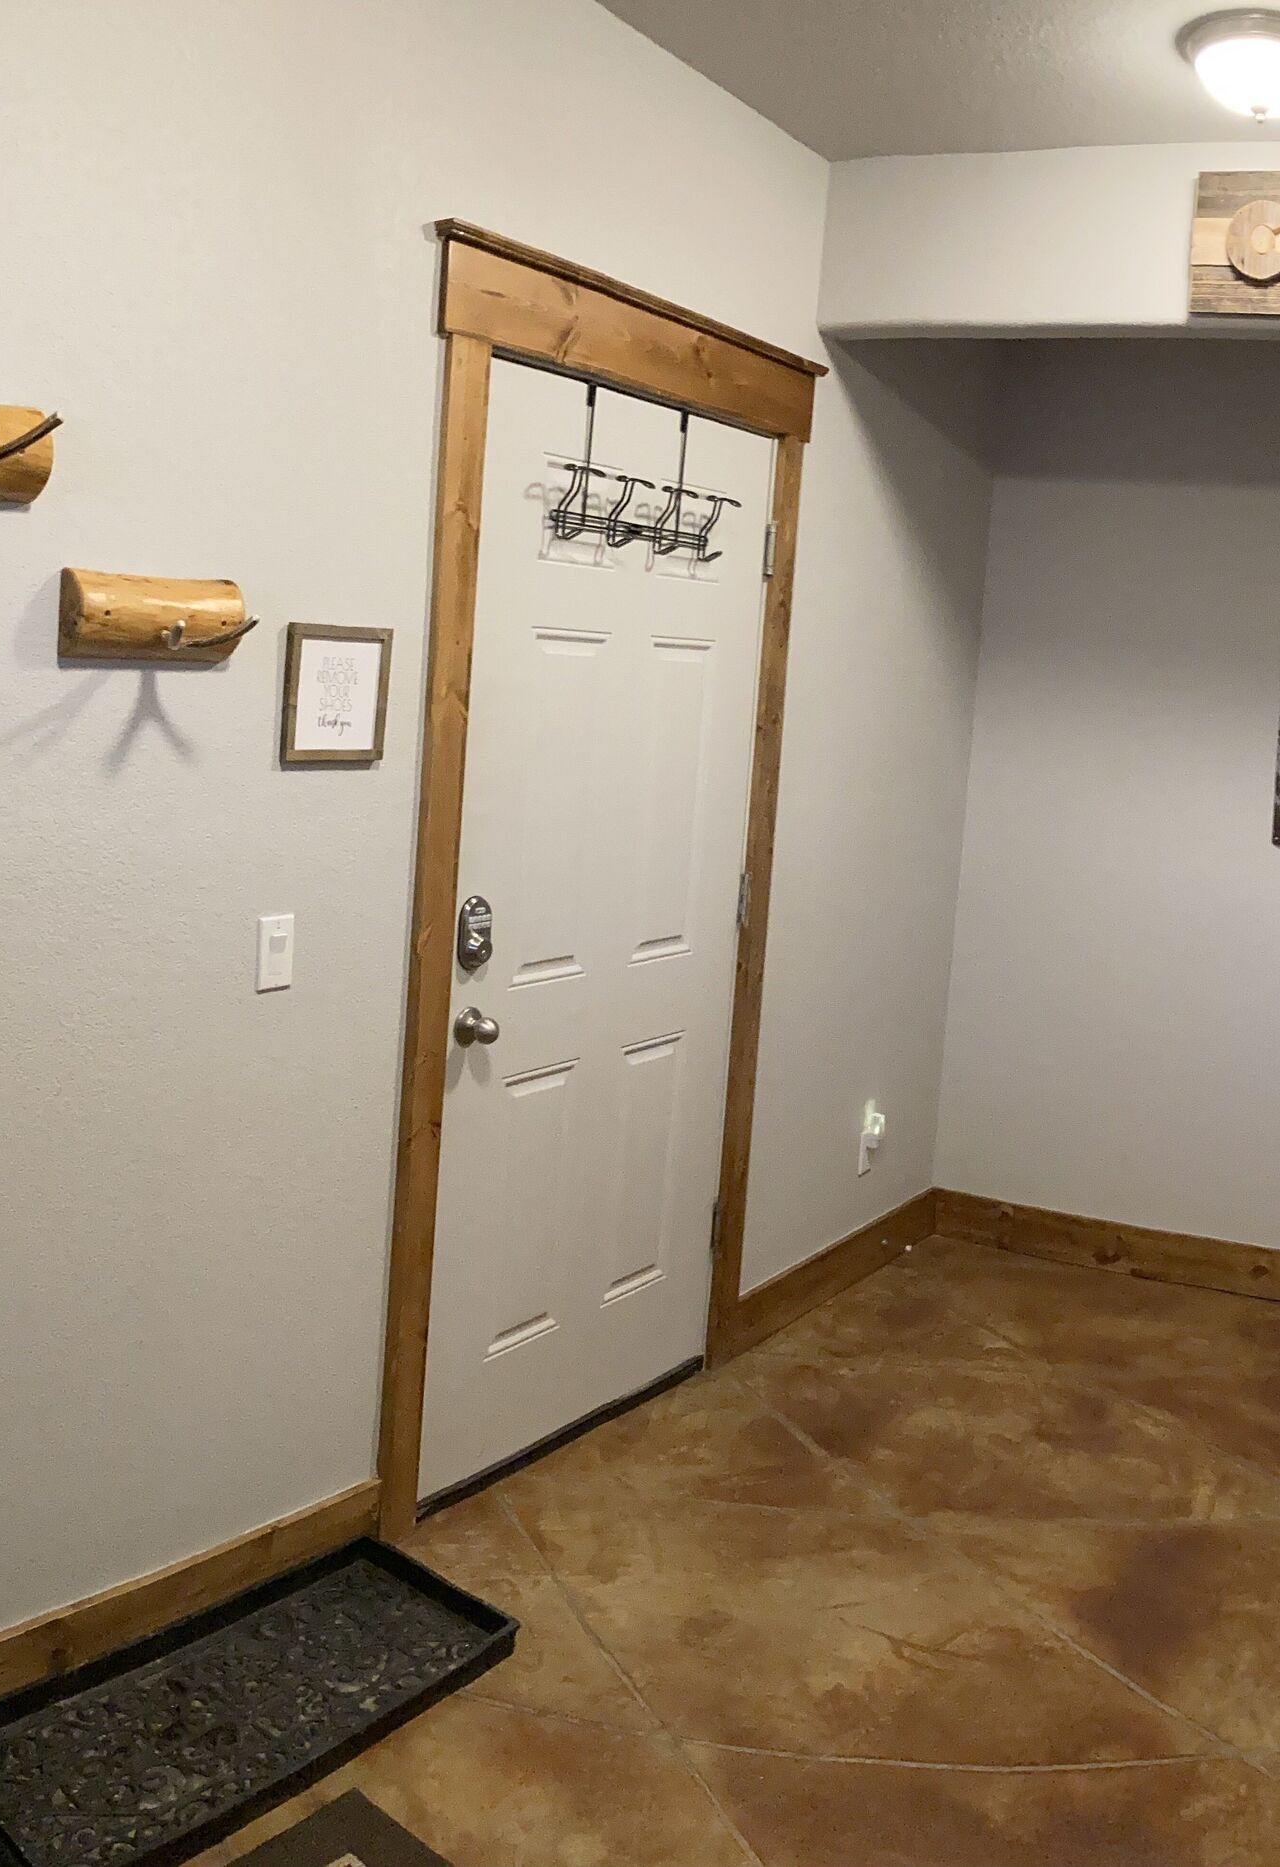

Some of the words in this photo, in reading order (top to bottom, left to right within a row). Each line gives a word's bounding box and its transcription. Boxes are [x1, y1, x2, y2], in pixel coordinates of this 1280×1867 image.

[322, 656, 356, 671] PLEASE
[317, 670, 358, 685] REMOVE
[323, 684, 350, 698] YOUR
[319, 697, 353, 712] SHOES
[317, 713, 340, 729] thank
[337, 720, 352, 736] you
